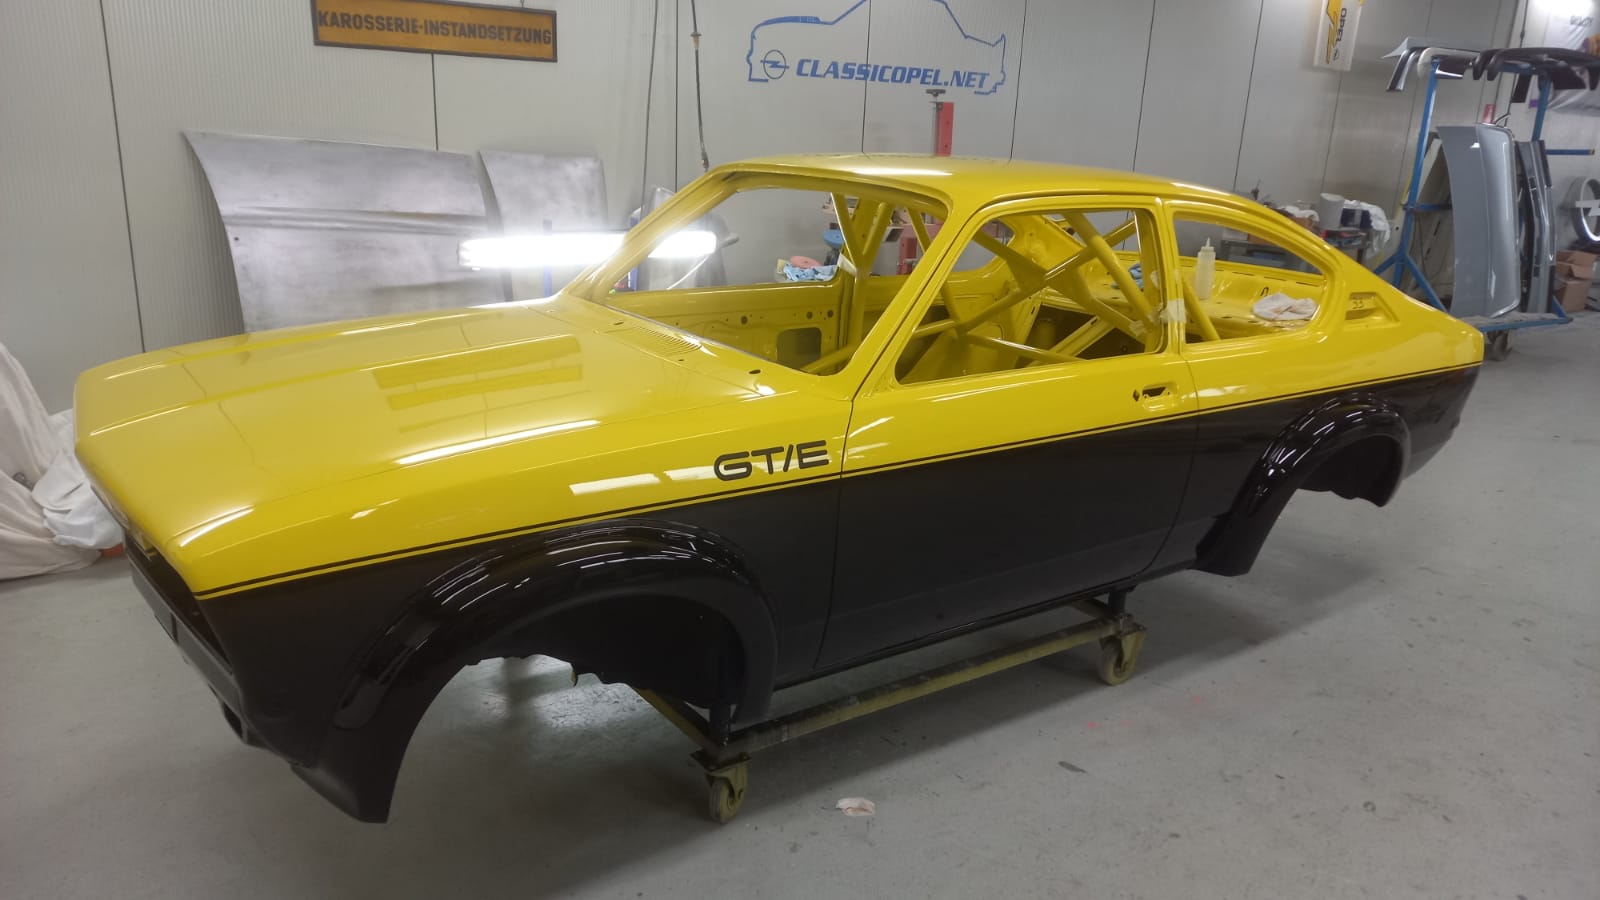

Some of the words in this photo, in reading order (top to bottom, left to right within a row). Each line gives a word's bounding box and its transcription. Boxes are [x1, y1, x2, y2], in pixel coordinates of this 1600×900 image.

[318, 10, 551, 45] KAROSSERIE-INSTANDSETZUNG
[796, 58, 990, 89] CLASSICOPEL.NET
[713, 439, 830, 482] GT/E
